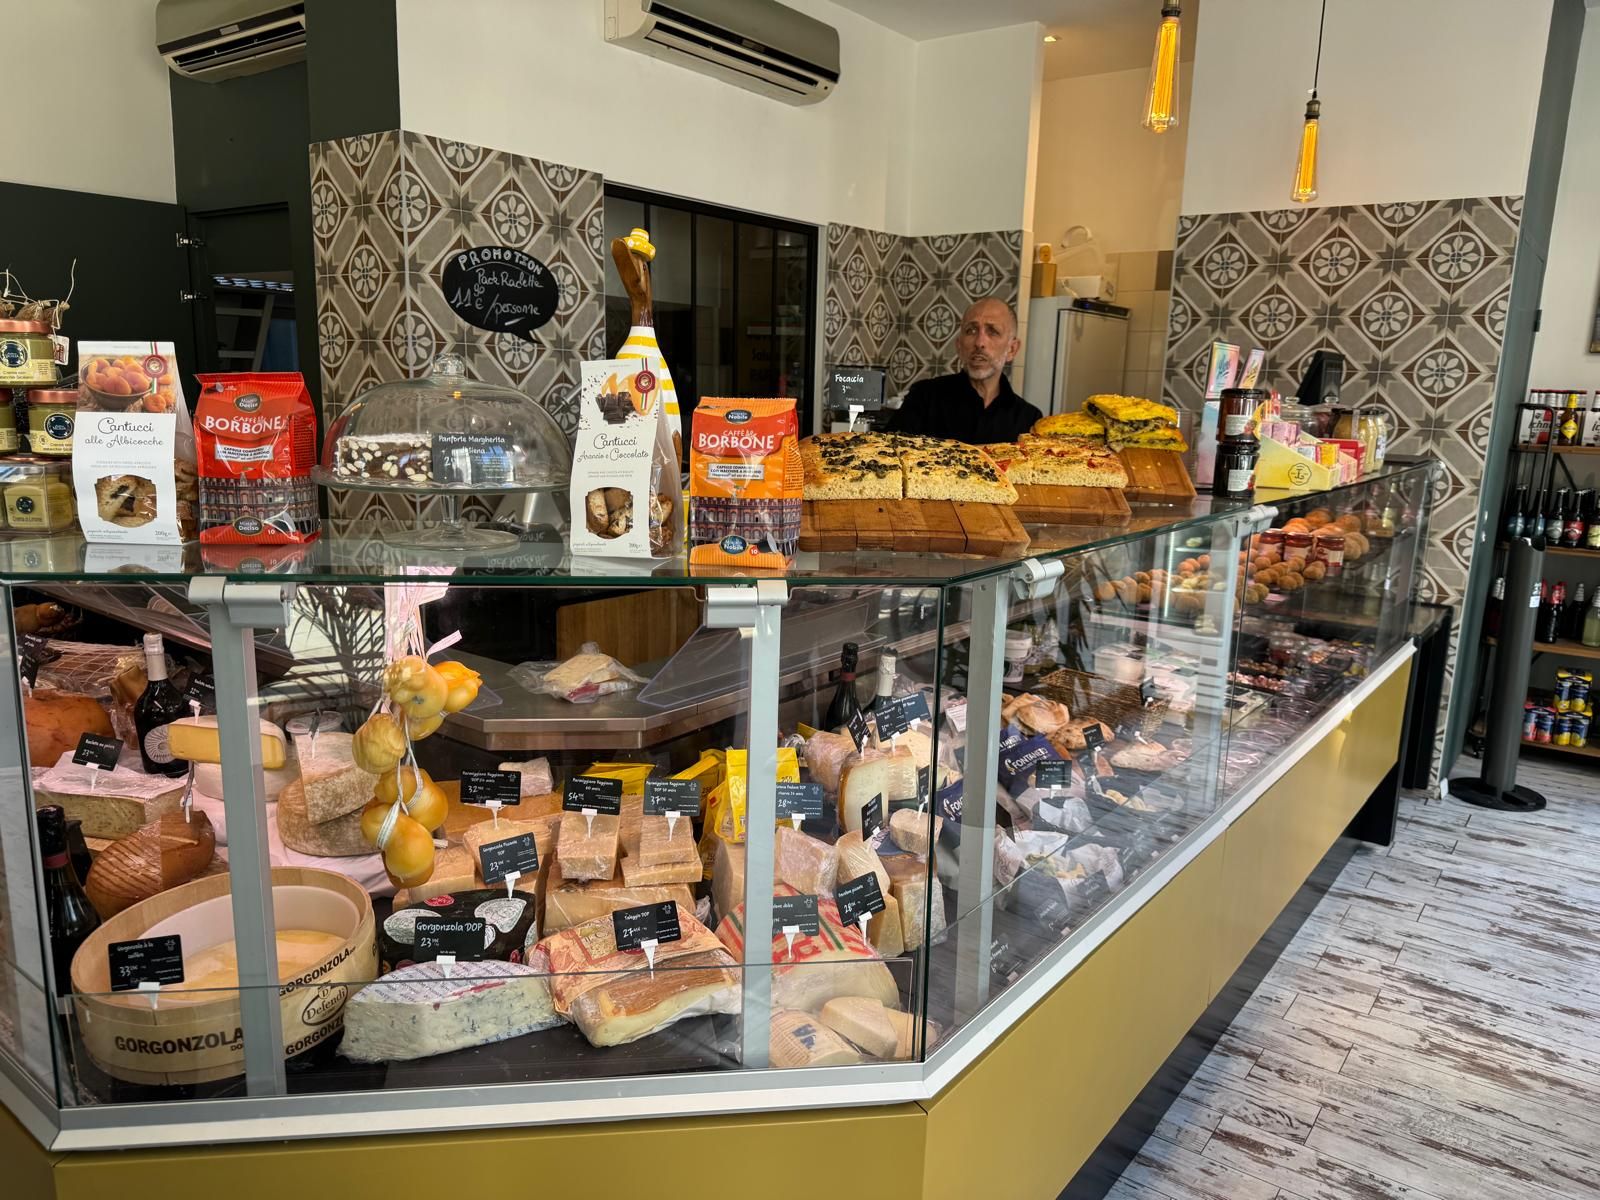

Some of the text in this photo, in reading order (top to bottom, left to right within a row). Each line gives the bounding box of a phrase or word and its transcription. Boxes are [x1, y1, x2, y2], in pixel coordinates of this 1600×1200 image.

[458, 248, 543, 275] PROMOTION
[476, 268, 544, 289] Pack Raclette
[835, 374, 864, 384] Focaccia
[97, 417, 153, 435] Cantucci
[205, 415, 282, 434] BORBONE
[85, 434, 164, 449] alle Albicocche
[468, 435, 506, 445] Margherita
[593, 433, 637, 450] Cantucci
[698, 432, 774, 450] BORBONE
[576, 450, 605, 463] Arancio
[609, 447, 649, 461] Cioccolato
[416, 921, 483, 934] Gorgonzola DOP
[279, 948, 350, 997] GORGONZOLA
[306, 988, 346, 1021] Defendi
[115, 1027, 243, 1056] GORGONZOLA
[285, 1015, 345, 1056] GORGONZ
[230, 1044, 243, 1052] DO
